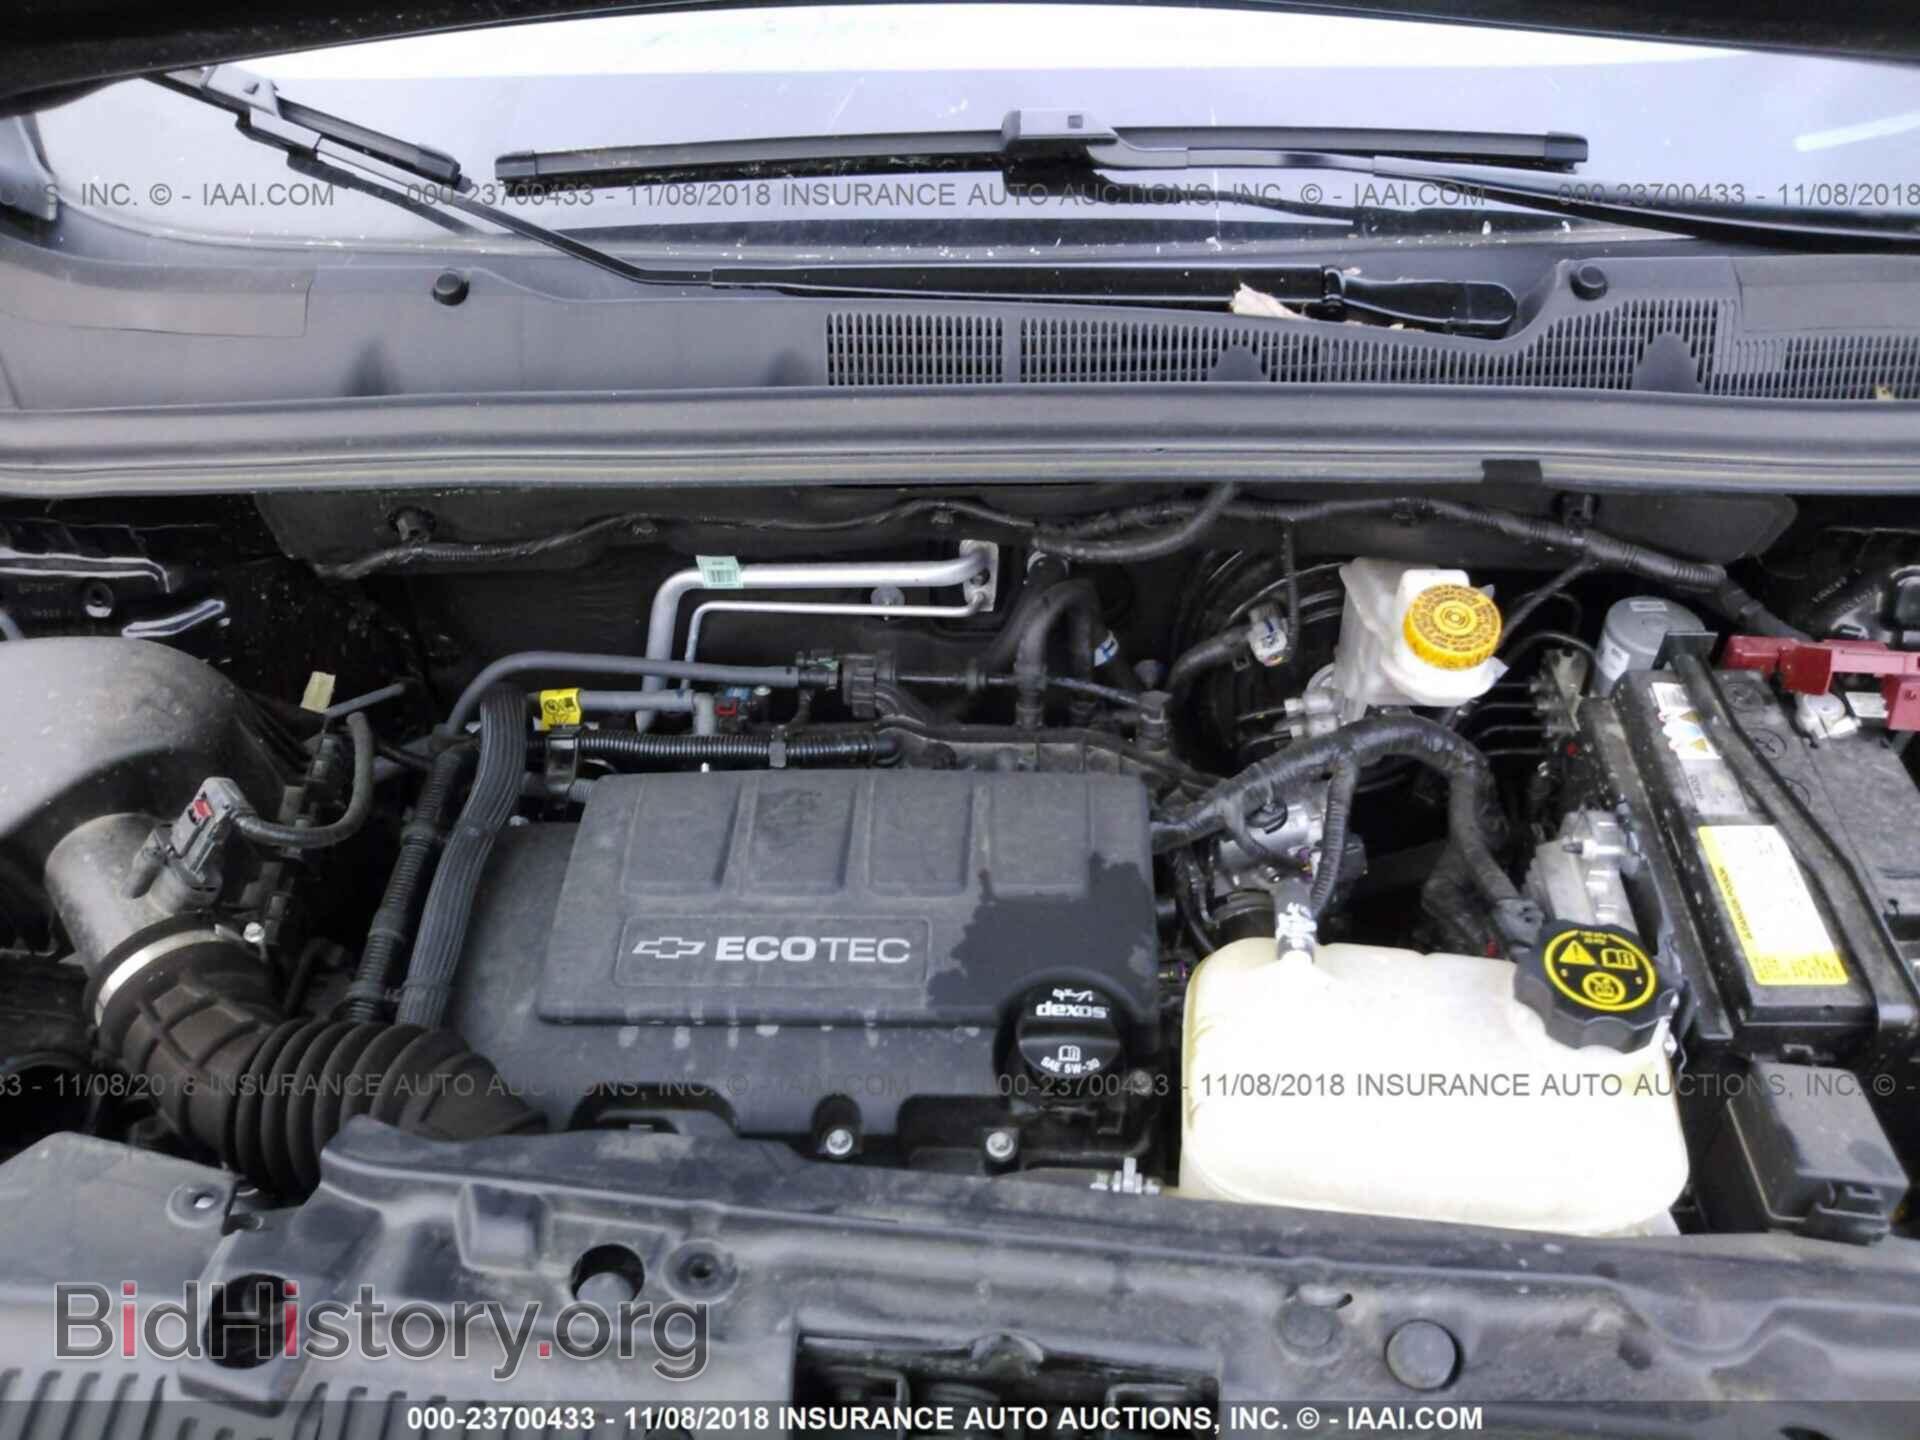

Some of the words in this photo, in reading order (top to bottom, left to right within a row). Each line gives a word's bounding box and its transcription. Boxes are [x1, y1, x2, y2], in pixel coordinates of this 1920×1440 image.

[715, 936, 912, 964] ECOTEC
[1036, 1000, 1107, 1019] dexos
[1040, 1055, 1062, 1073] SAE
[1064, 1057, 1101, 1075] 5W-30
